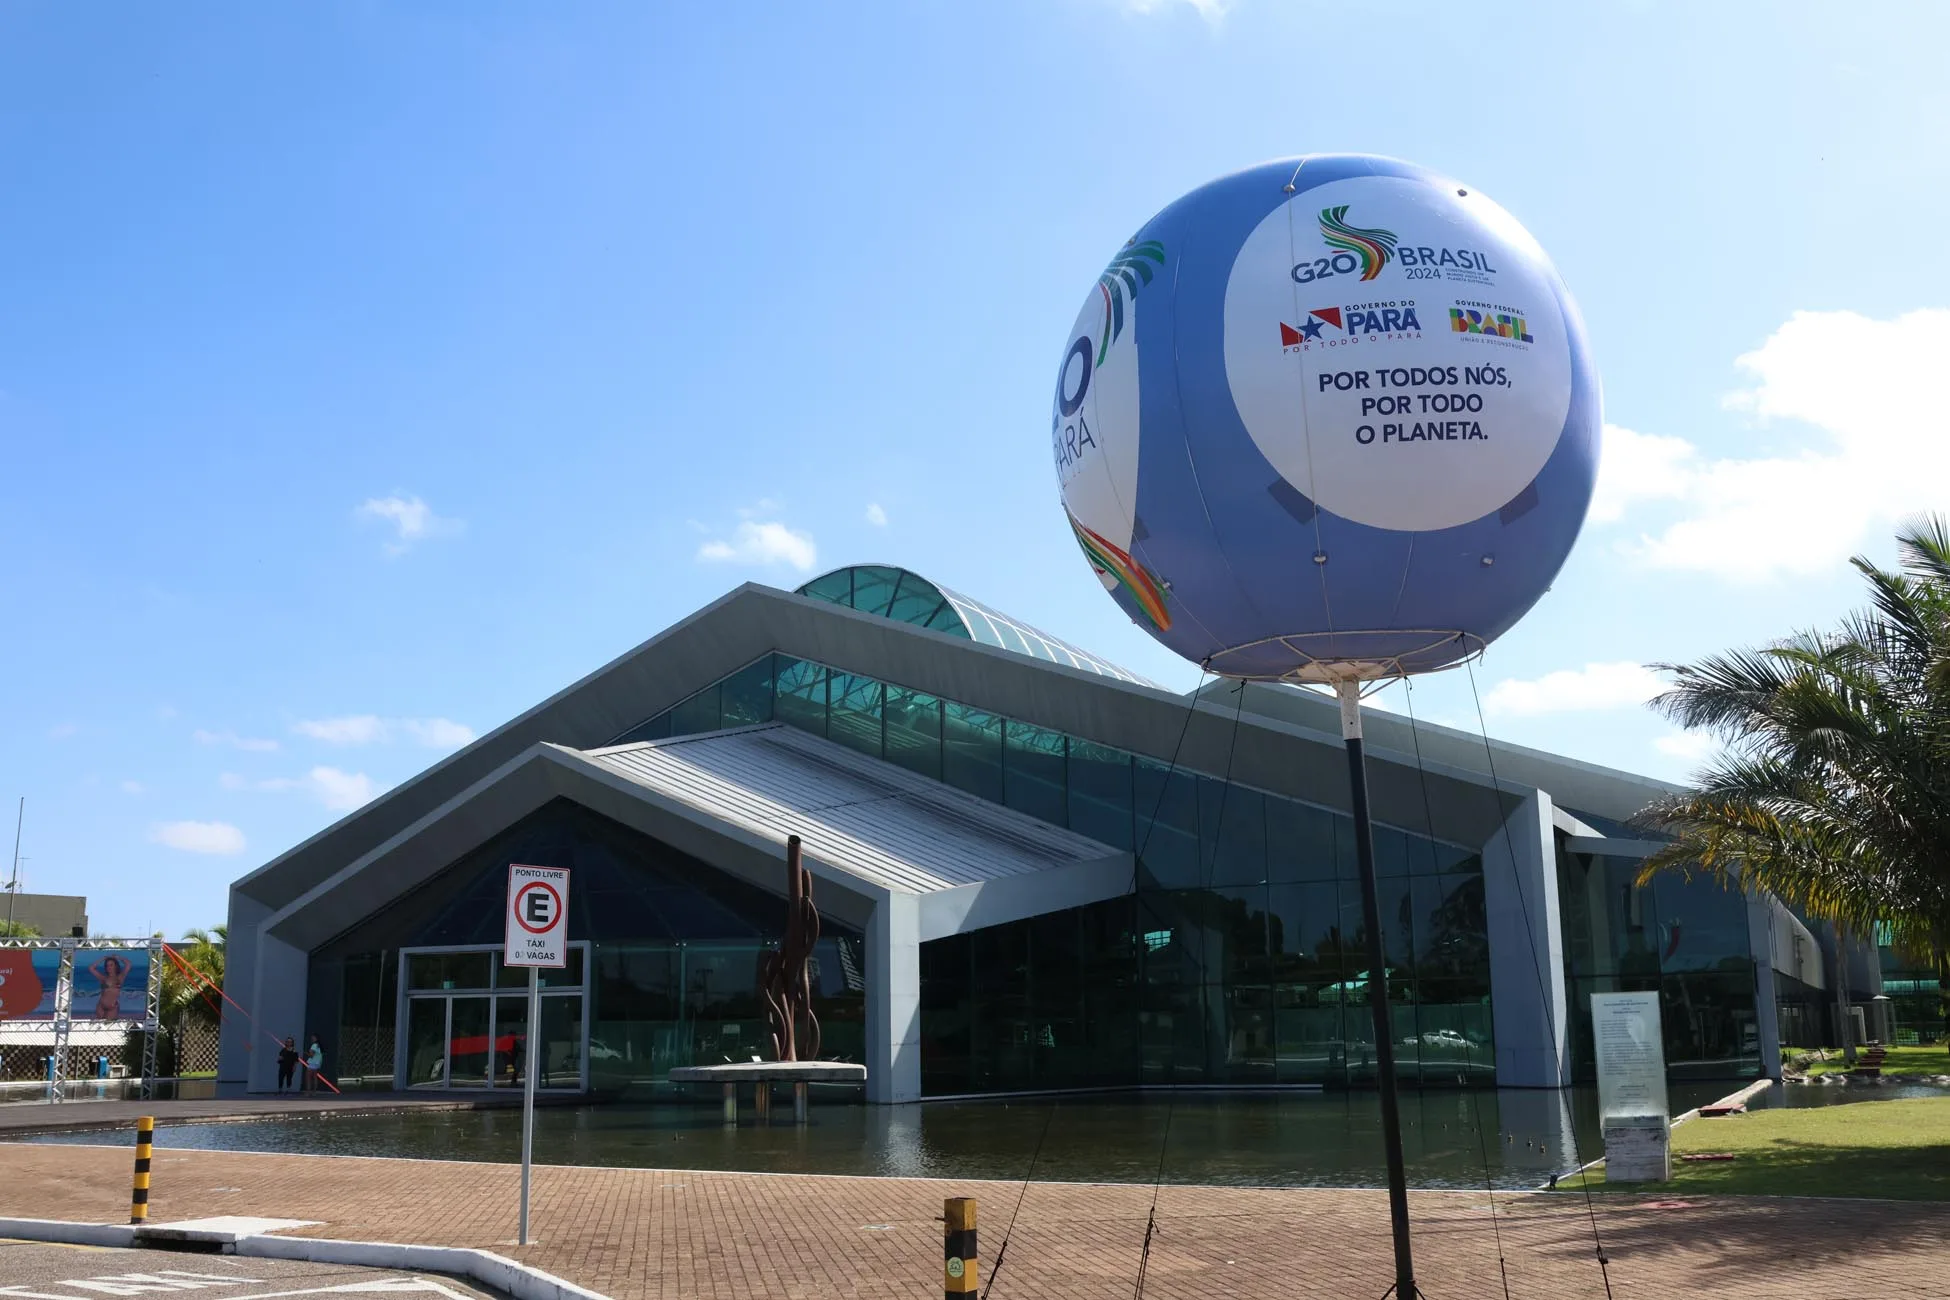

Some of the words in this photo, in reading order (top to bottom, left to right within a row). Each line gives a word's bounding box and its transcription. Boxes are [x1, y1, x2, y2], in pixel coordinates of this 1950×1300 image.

[1291, 254, 1357, 283] G20
[1397, 247, 1496, 274] BRASIL
[1405, 267, 1441, 280] 2024
[1345, 301, 1396, 312] GOVERNO
[1455, 299, 1492, 309] GOVERNO
[1494, 304, 1524, 316] FEDERAL
[1346, 308, 1421, 336] PARÁ
[1449, 308, 1534, 344] BRASIL
[1283, 344, 1310, 355] POR
[1320, 337, 1359, 348] TODO
[1388, 332, 1422, 340] PARÁ
[1319, 370, 1370, 392] POR
[1376, 366, 1458, 388] TODOS
[1465, 362, 1512, 389] NÓS,
[1361, 395, 1412, 416] POR
[1417, 393, 1483, 413] TODO
[1355, 425, 1375, 445] O
[1383, 421, 1489, 443] PLANETA.
[515, 869, 541, 878] PONTO
[543, 870, 564, 879] LIVRE
[527, 893, 549, 922] E
[527, 951, 555, 960] VAGAS
